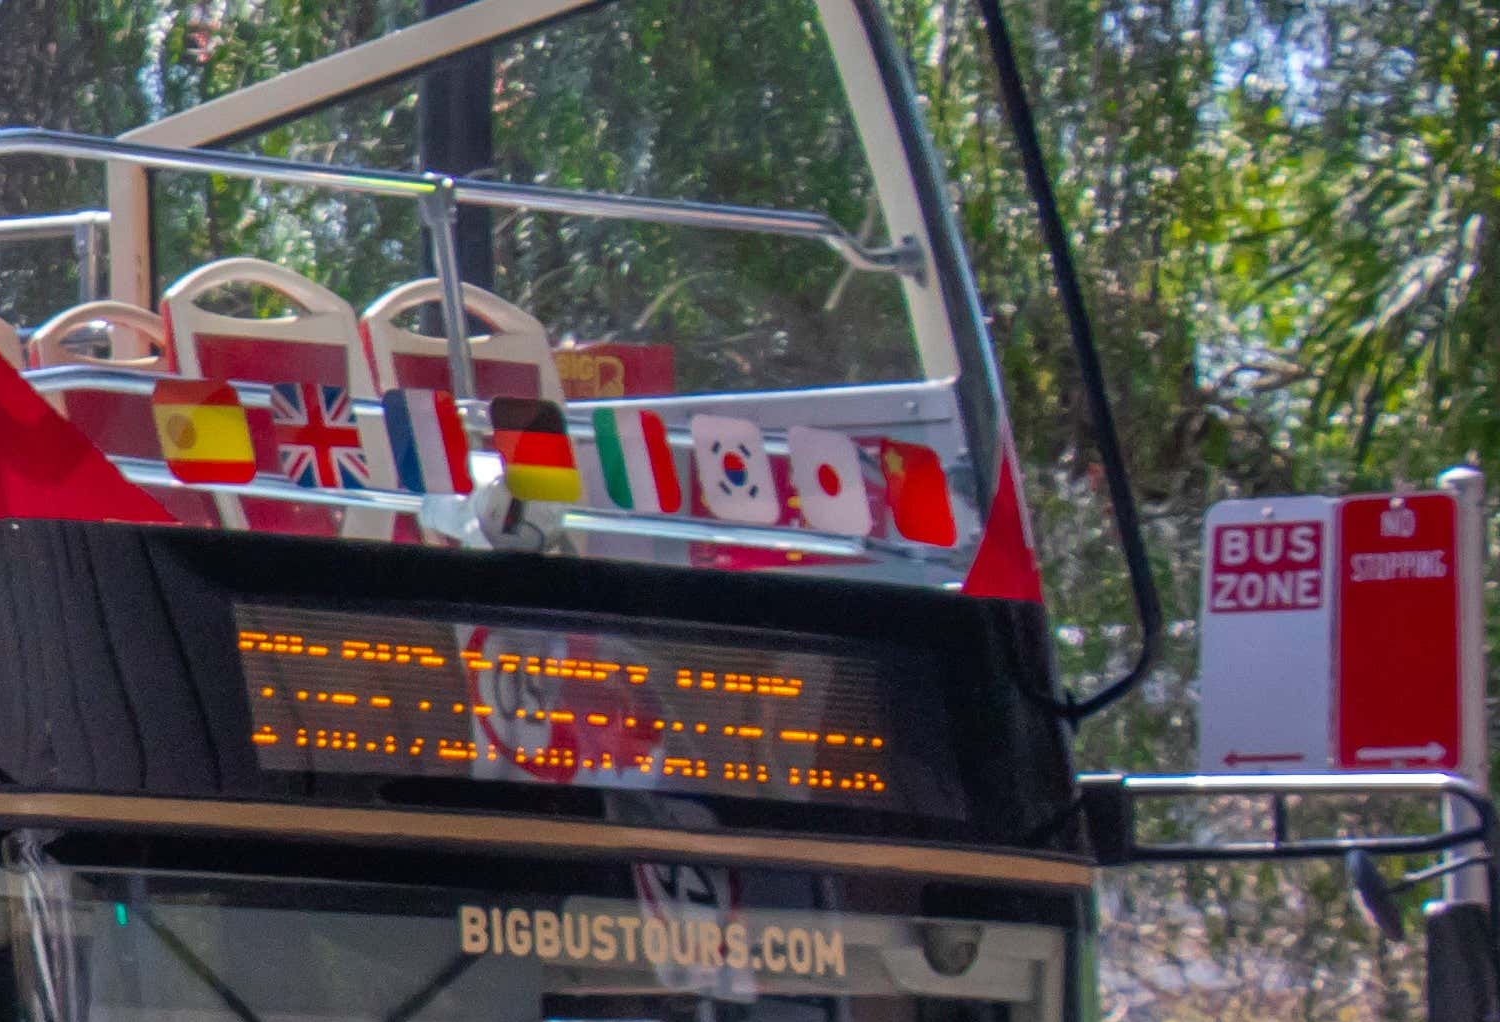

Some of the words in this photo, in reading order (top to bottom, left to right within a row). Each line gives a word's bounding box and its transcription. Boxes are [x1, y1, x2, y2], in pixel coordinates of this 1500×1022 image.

[1380, 508, 1416, 538] NO
[1220, 525, 1317, 567] BUS
[1350, 550, 1448, 582] STOPPING
[1214, 568, 1320, 608] ZONE
[458, 904, 846, 977] BIGBUSTOURS.COM
